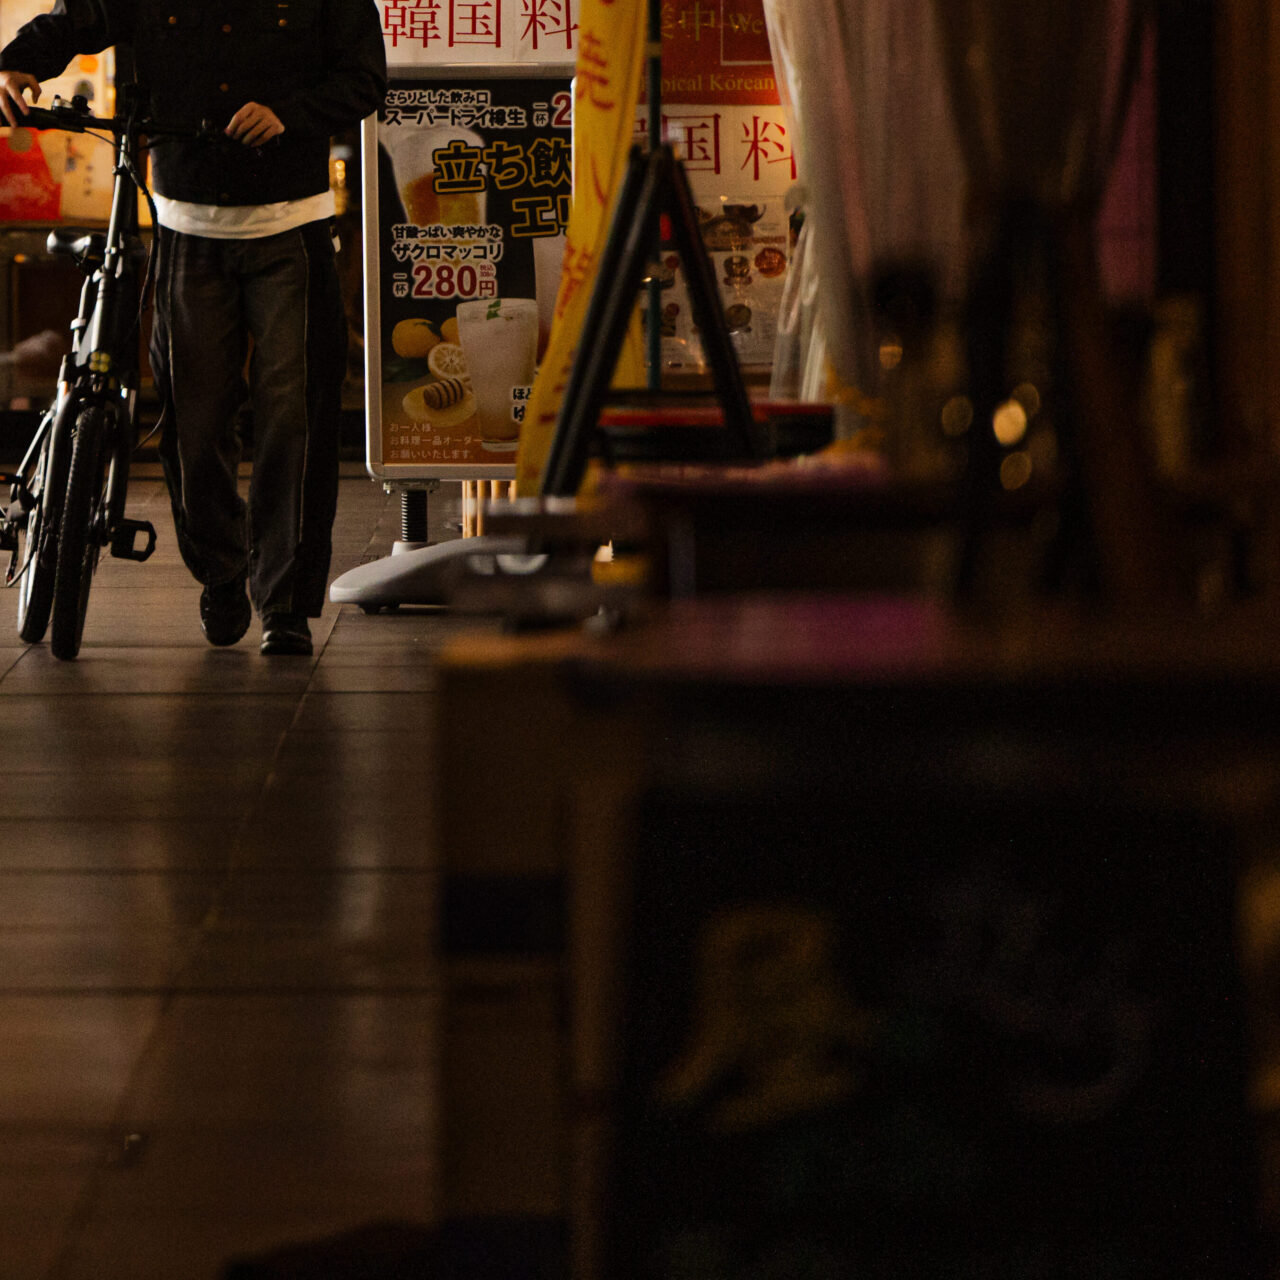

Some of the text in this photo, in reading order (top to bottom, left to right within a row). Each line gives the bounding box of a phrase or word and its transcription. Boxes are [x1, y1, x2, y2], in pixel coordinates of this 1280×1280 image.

[710, 73, 774, 91] Korean
[386, 91, 489, 104] さらりとした飲み口
[393, 243, 502, 260] ザクロマッコリ
